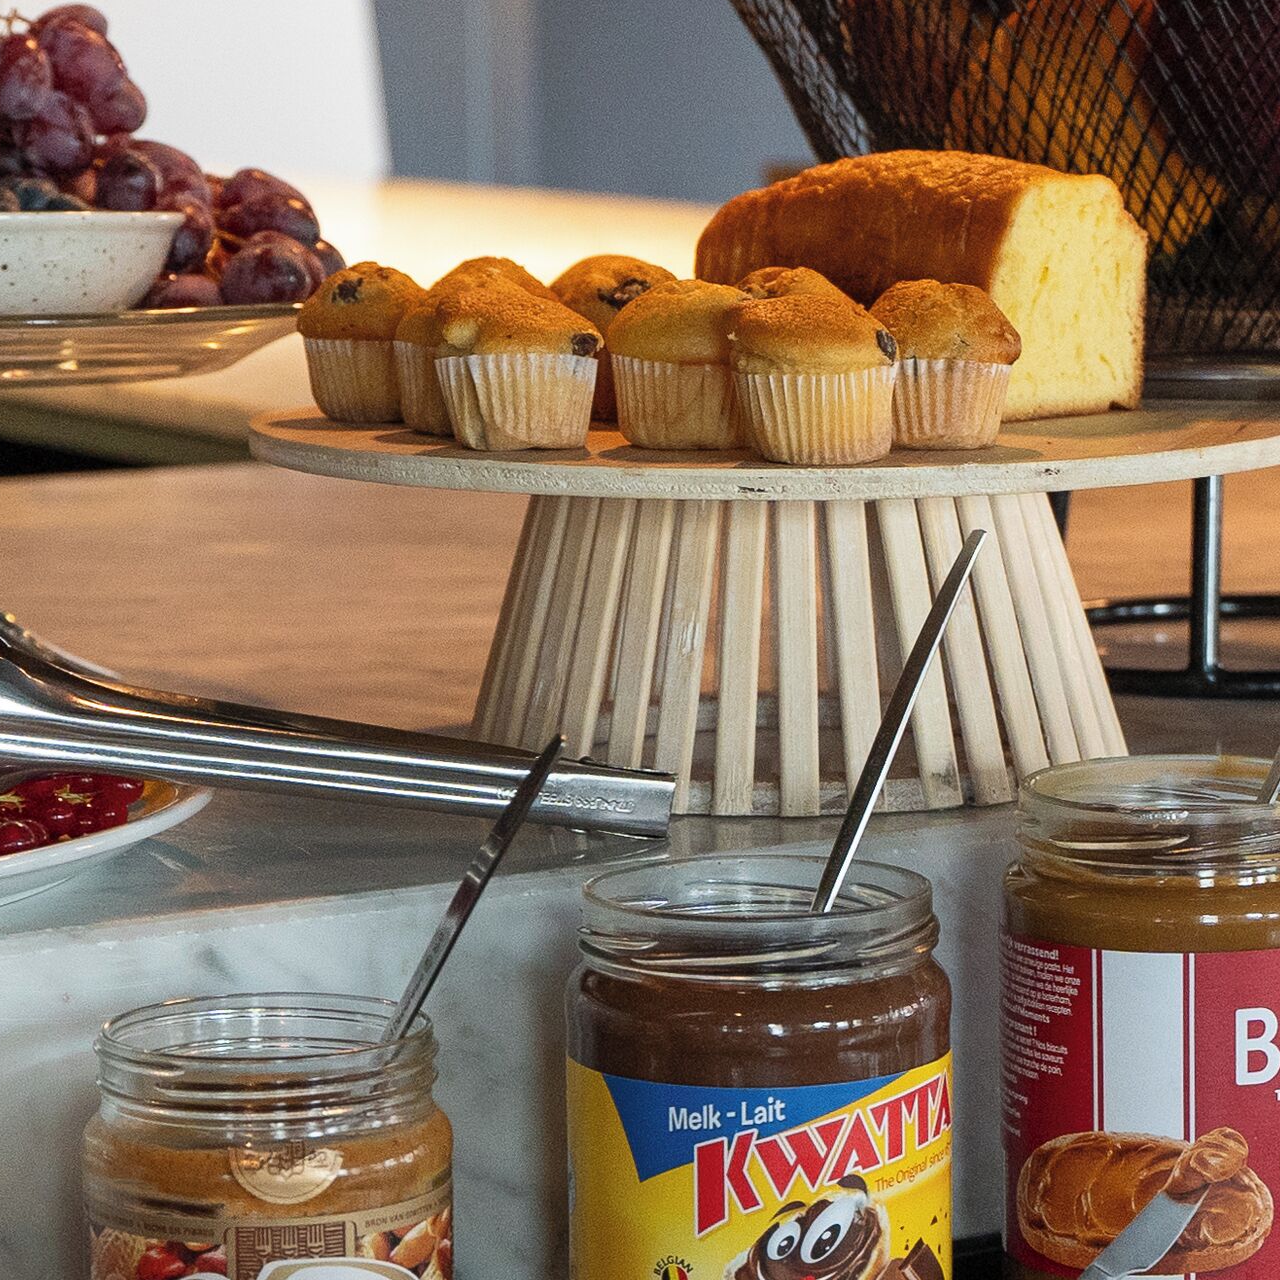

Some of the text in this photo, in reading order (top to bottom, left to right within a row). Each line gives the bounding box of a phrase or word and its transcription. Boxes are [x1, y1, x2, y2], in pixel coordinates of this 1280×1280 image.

[1062, 963, 1074, 974] Het
[1053, 982, 1078, 996] heerlijke
[1064, 977, 1081, 986] onze
[668, 1104, 722, 1132] Melk
[741, 1096, 787, 1126] Lait
[693, 1068, 952, 1238] KWATTA
[875, 1176, 895, 1192] The
[895, 1155, 928, 1183] Original
[365, 1217, 388, 1228] BRON
[653, 1255, 694, 1276] BELGIAN
